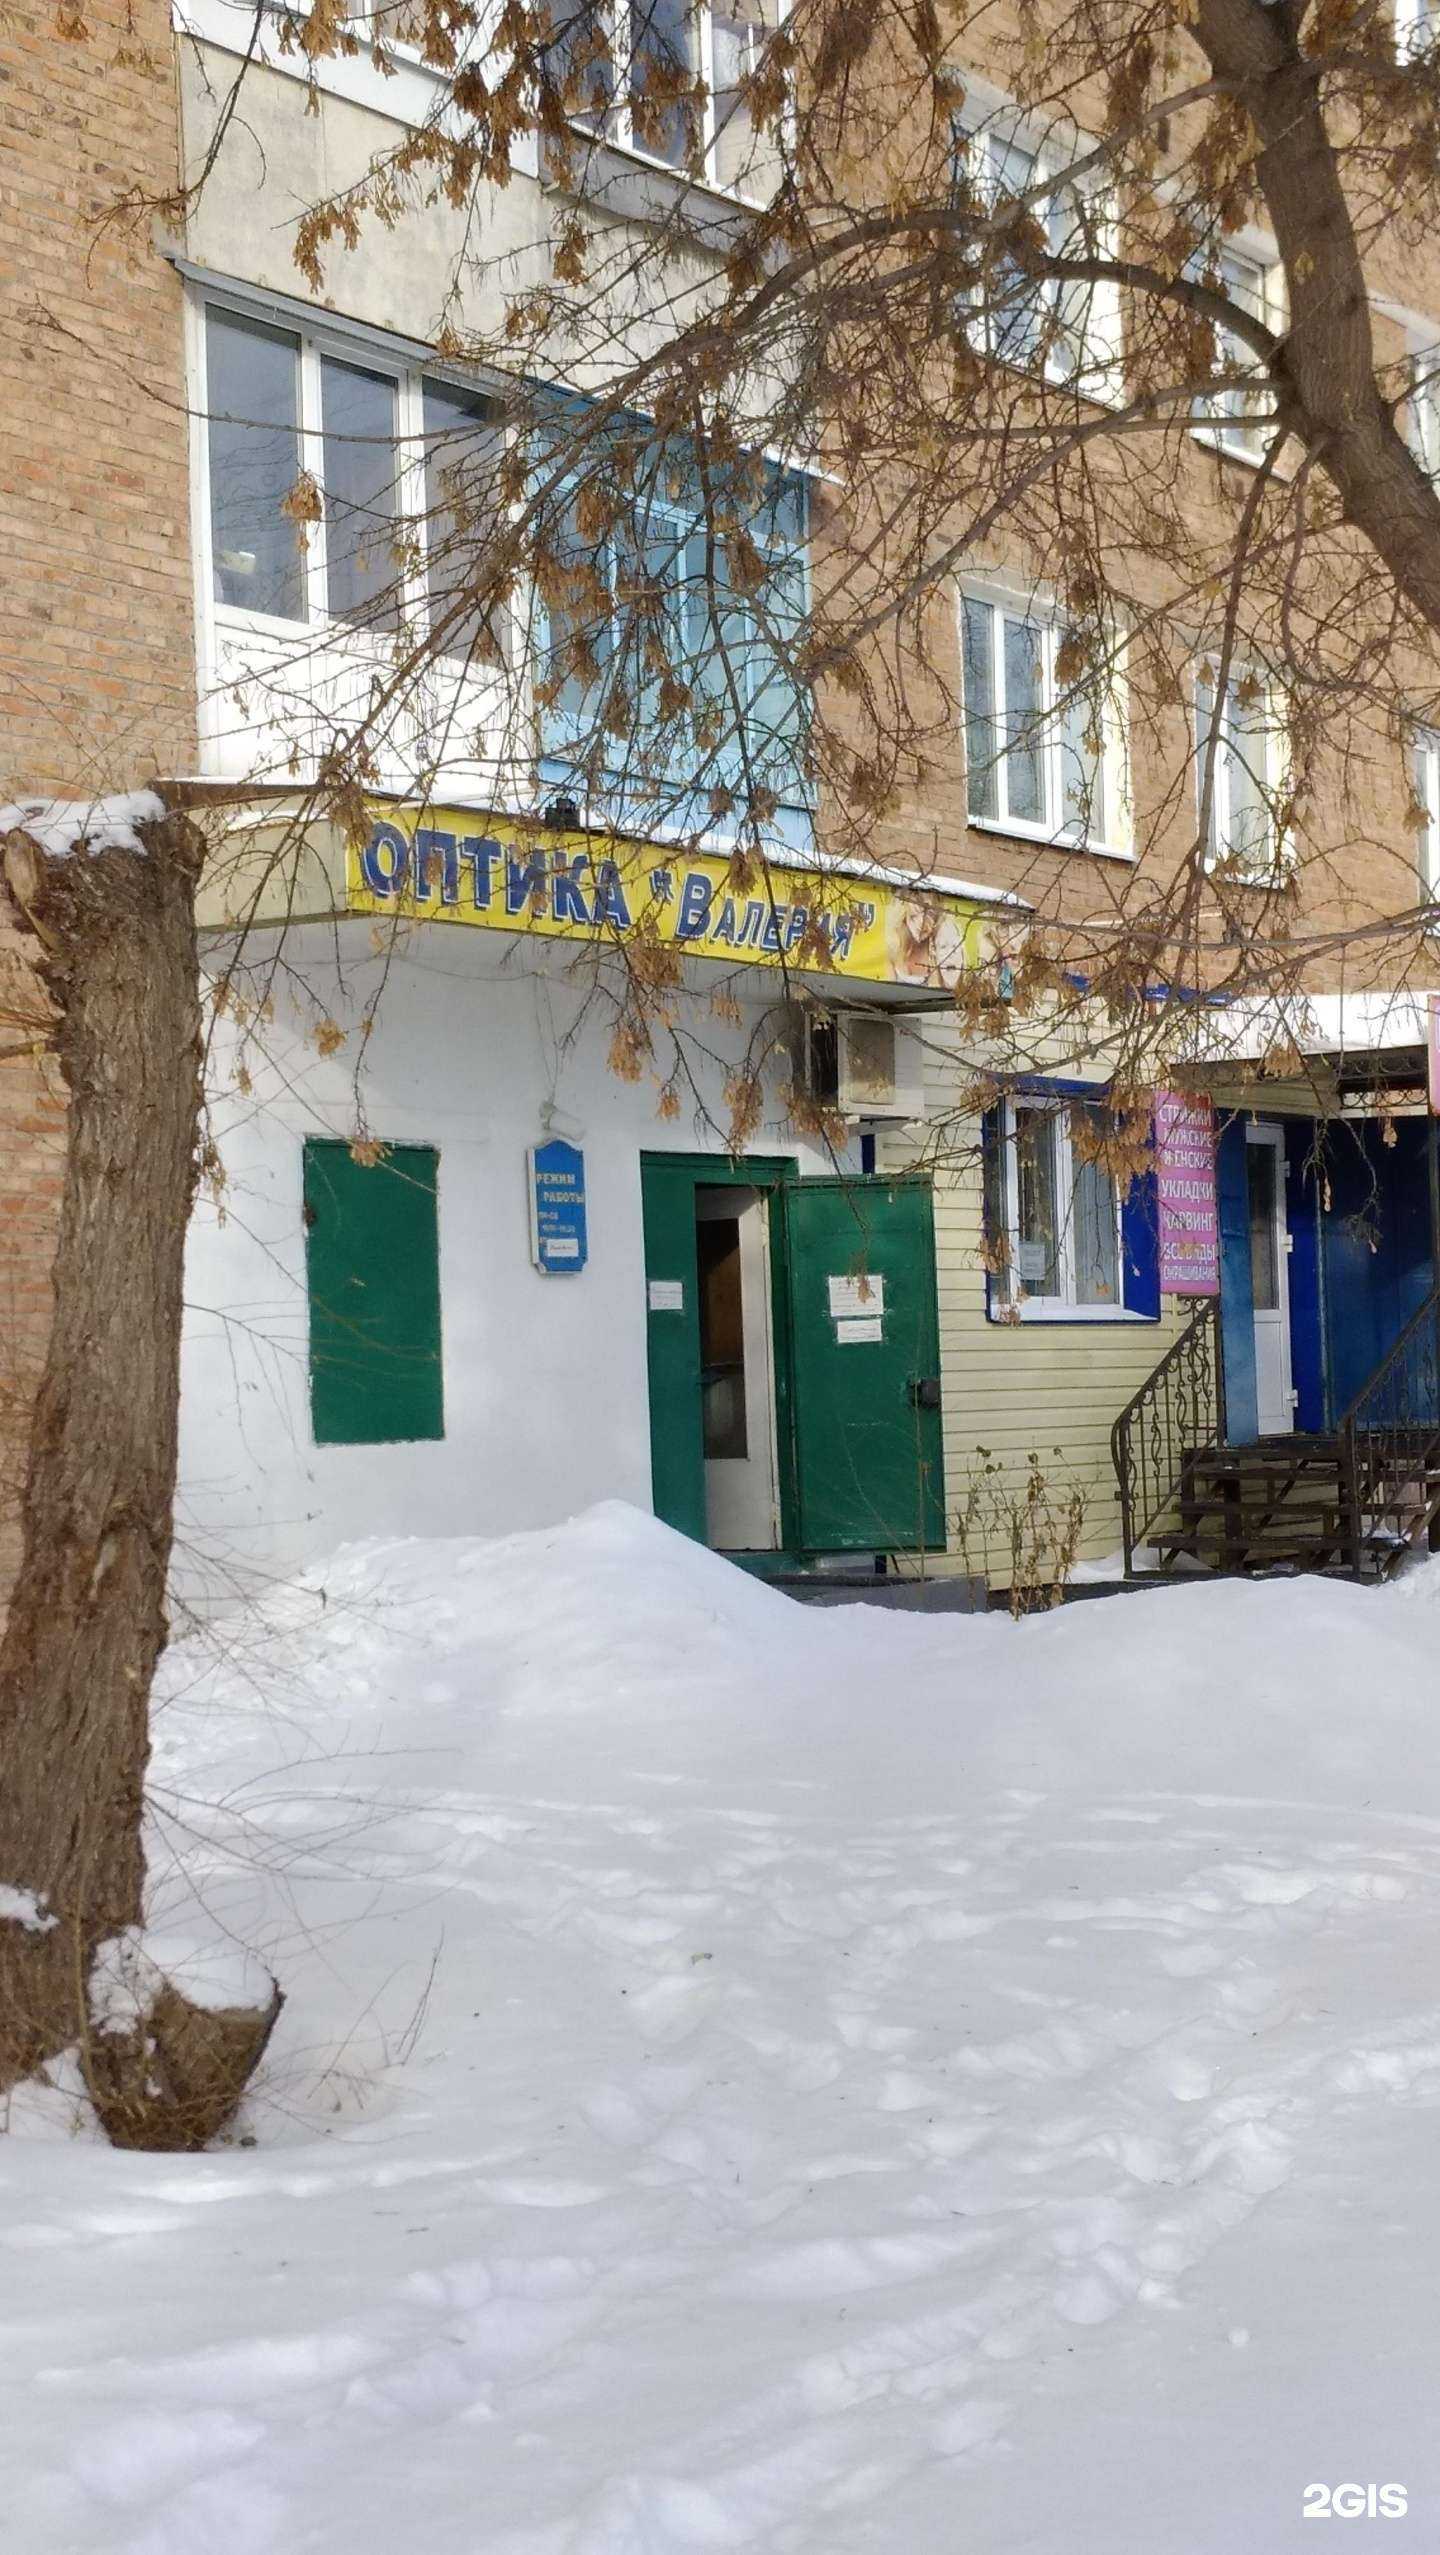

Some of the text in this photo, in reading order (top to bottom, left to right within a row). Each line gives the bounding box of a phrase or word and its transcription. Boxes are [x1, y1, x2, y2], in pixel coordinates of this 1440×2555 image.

[361, 822, 632, 930] ОПТИКА
[1158, 1104, 1211, 1127] СТРИЖКИ
[1161, 1149, 1215, 1170] ЖЕНСКИЕ
[1160, 1179, 1214, 1204] УКЛАДКИ
